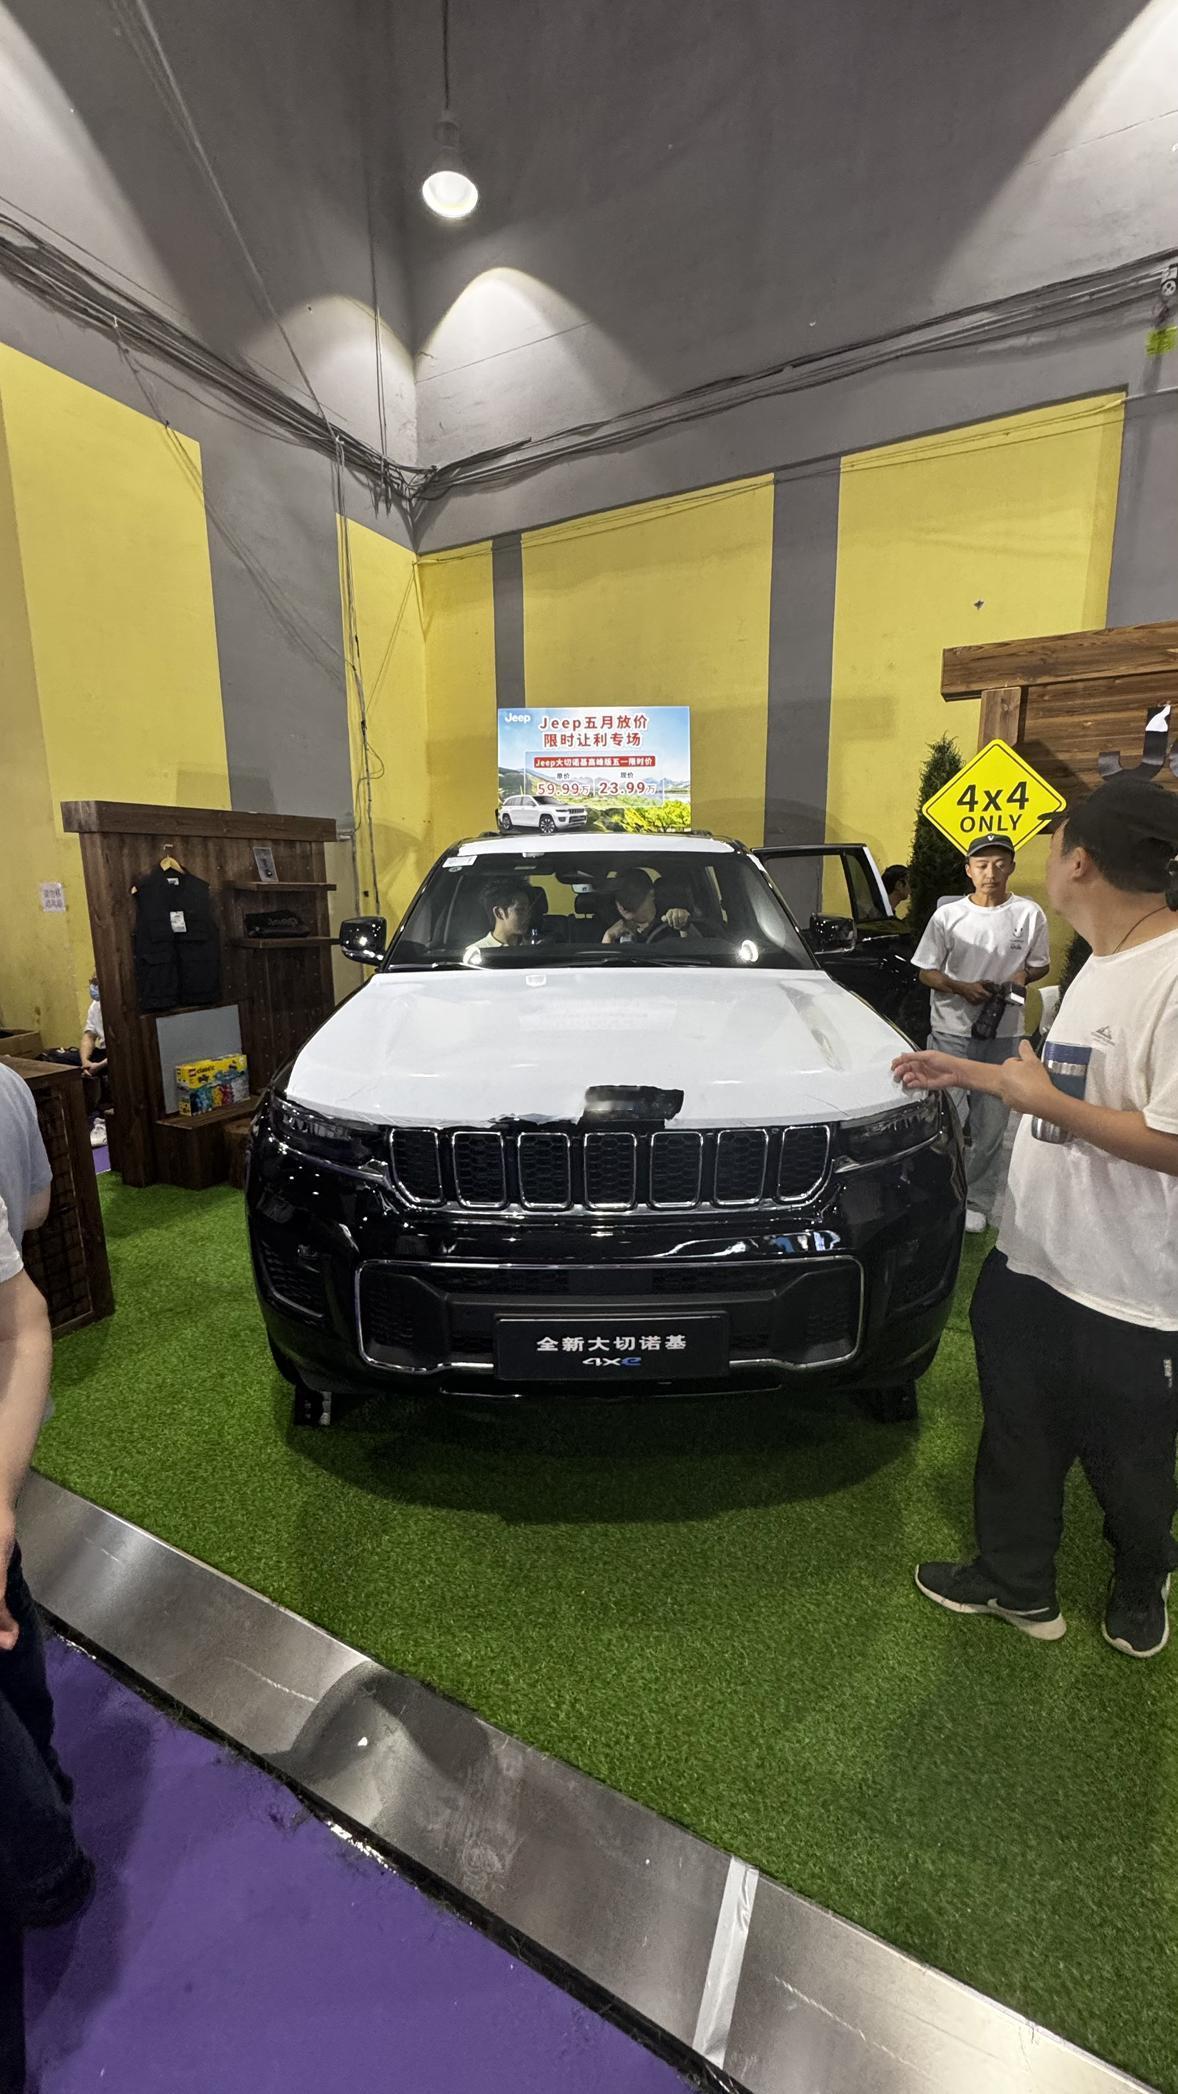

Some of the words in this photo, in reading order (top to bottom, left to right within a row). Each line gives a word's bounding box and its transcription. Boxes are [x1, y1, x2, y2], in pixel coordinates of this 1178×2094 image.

[505, 712, 531, 724] Jeep
[539, 715, 648, 730] Jeep五月放价
[544, 733, 641, 747] 限时让利专场
[957, 781, 1029, 813] 4x4
[960, 814, 1022, 832] ONLY
[536, 1335, 687, 1352] 全新大切诺基
